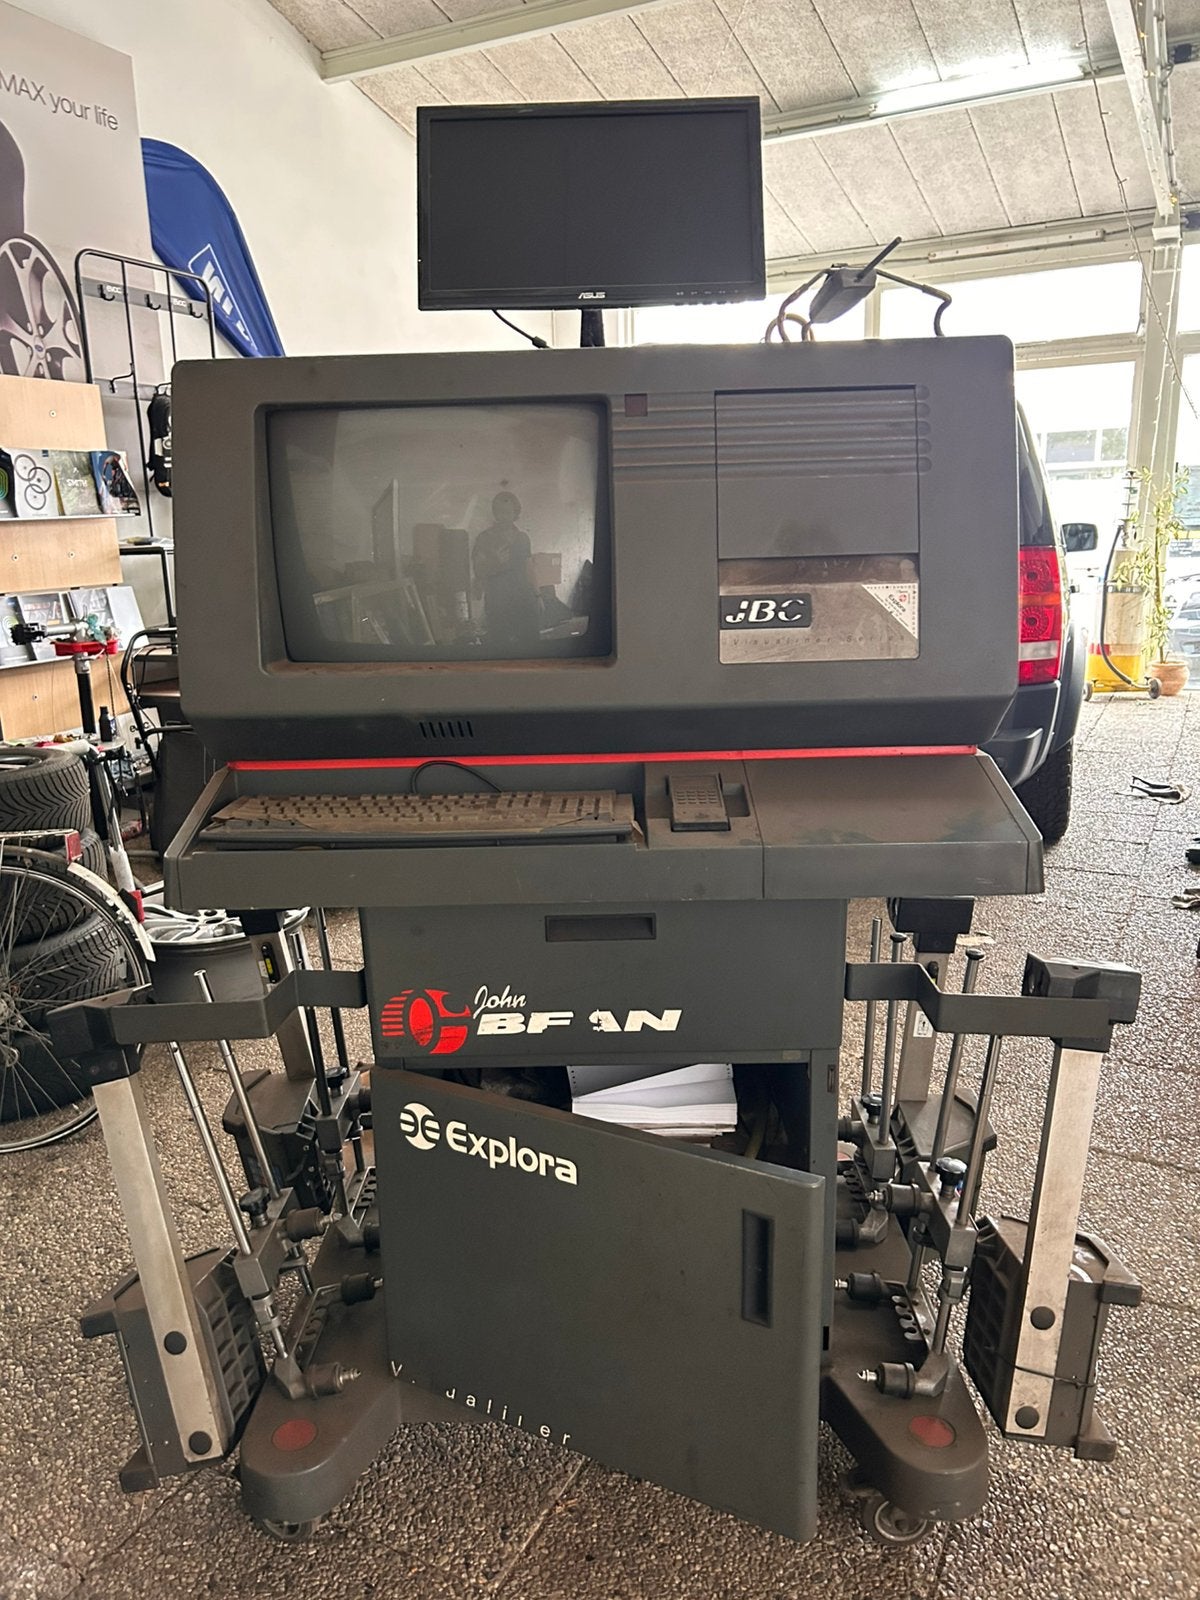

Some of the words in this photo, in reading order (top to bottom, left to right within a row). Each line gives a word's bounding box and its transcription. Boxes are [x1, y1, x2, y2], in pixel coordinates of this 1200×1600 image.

[49, 92, 90, 120] your
[94, 104, 118, 131] life
[578, 291, 606, 299] ASUS
[472, 984, 527, 1020] John
[445, 1120, 578, 1185] Explora
